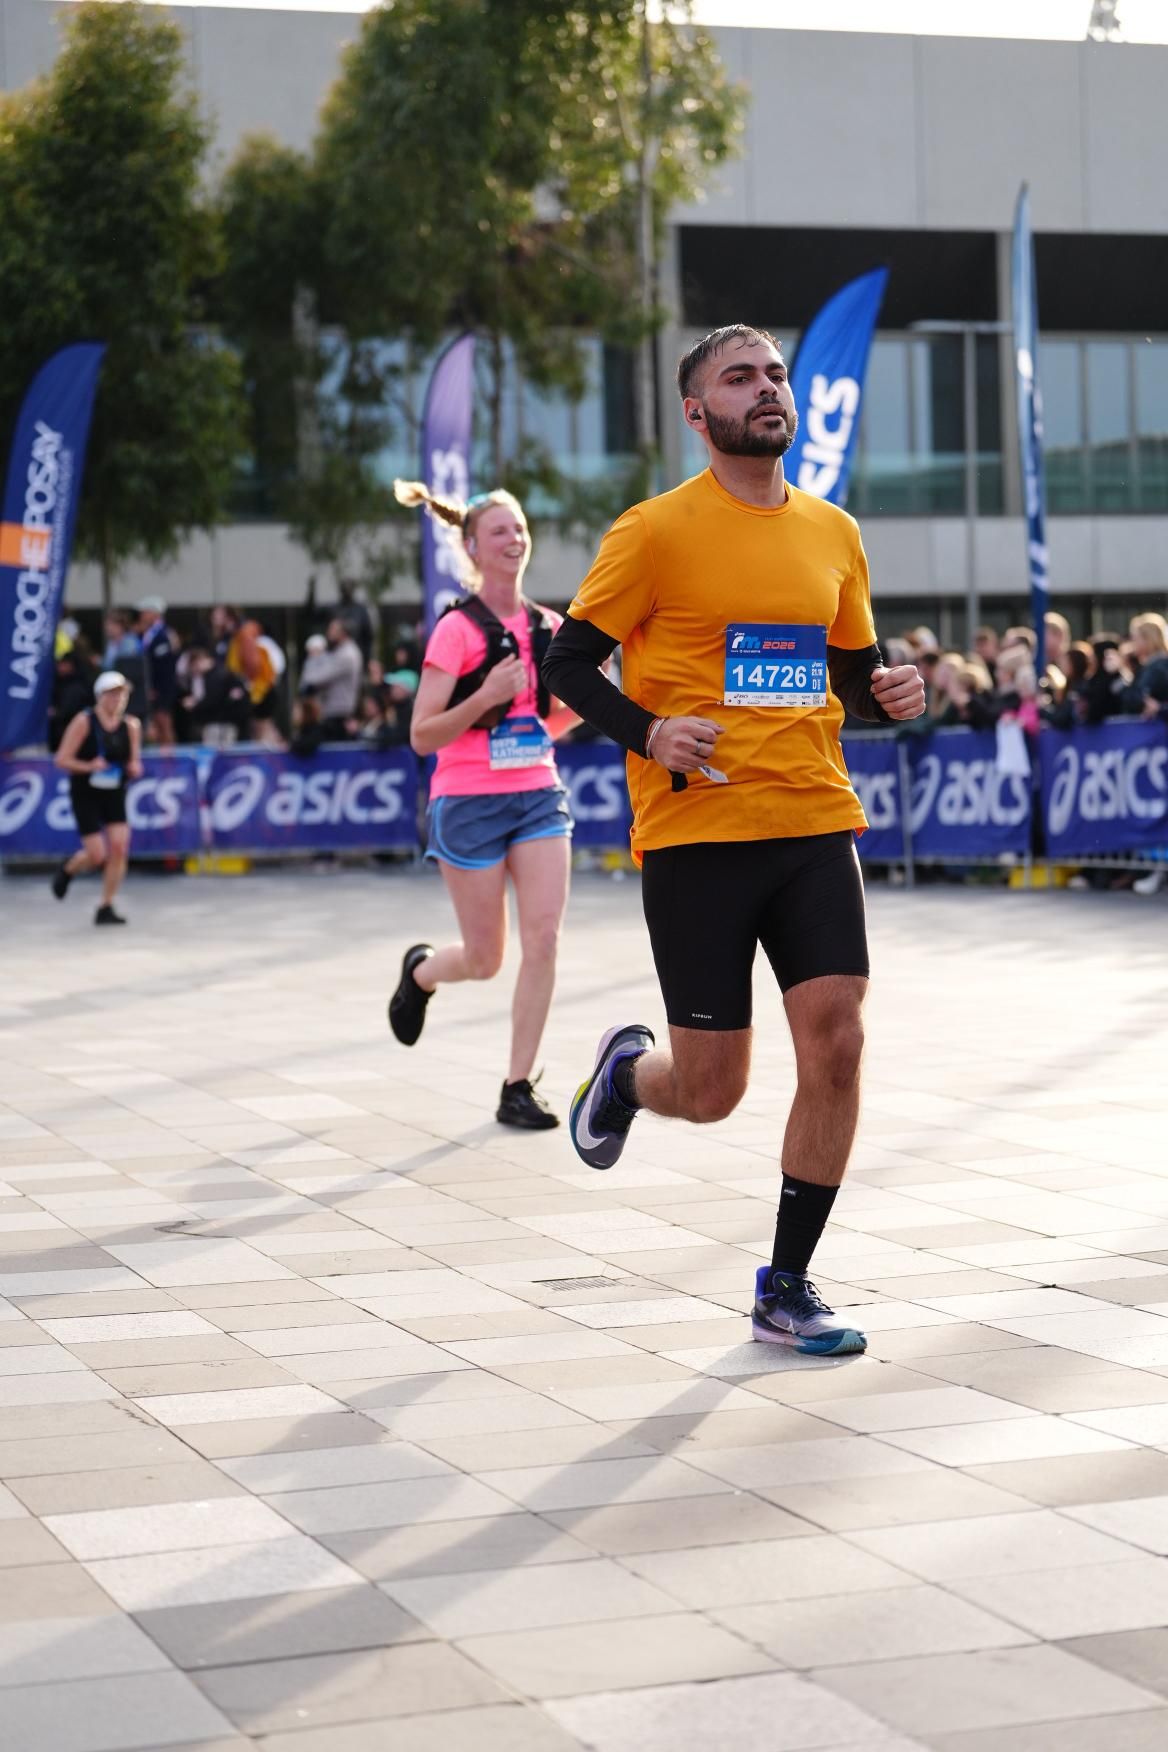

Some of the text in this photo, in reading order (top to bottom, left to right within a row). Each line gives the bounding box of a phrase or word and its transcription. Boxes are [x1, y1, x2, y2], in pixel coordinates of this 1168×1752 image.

[763, 641, 796, 650] 2026
[732, 665, 807, 688] 14726
[265, 769, 405, 826] asics
[937, 759, 1031, 827] asics
